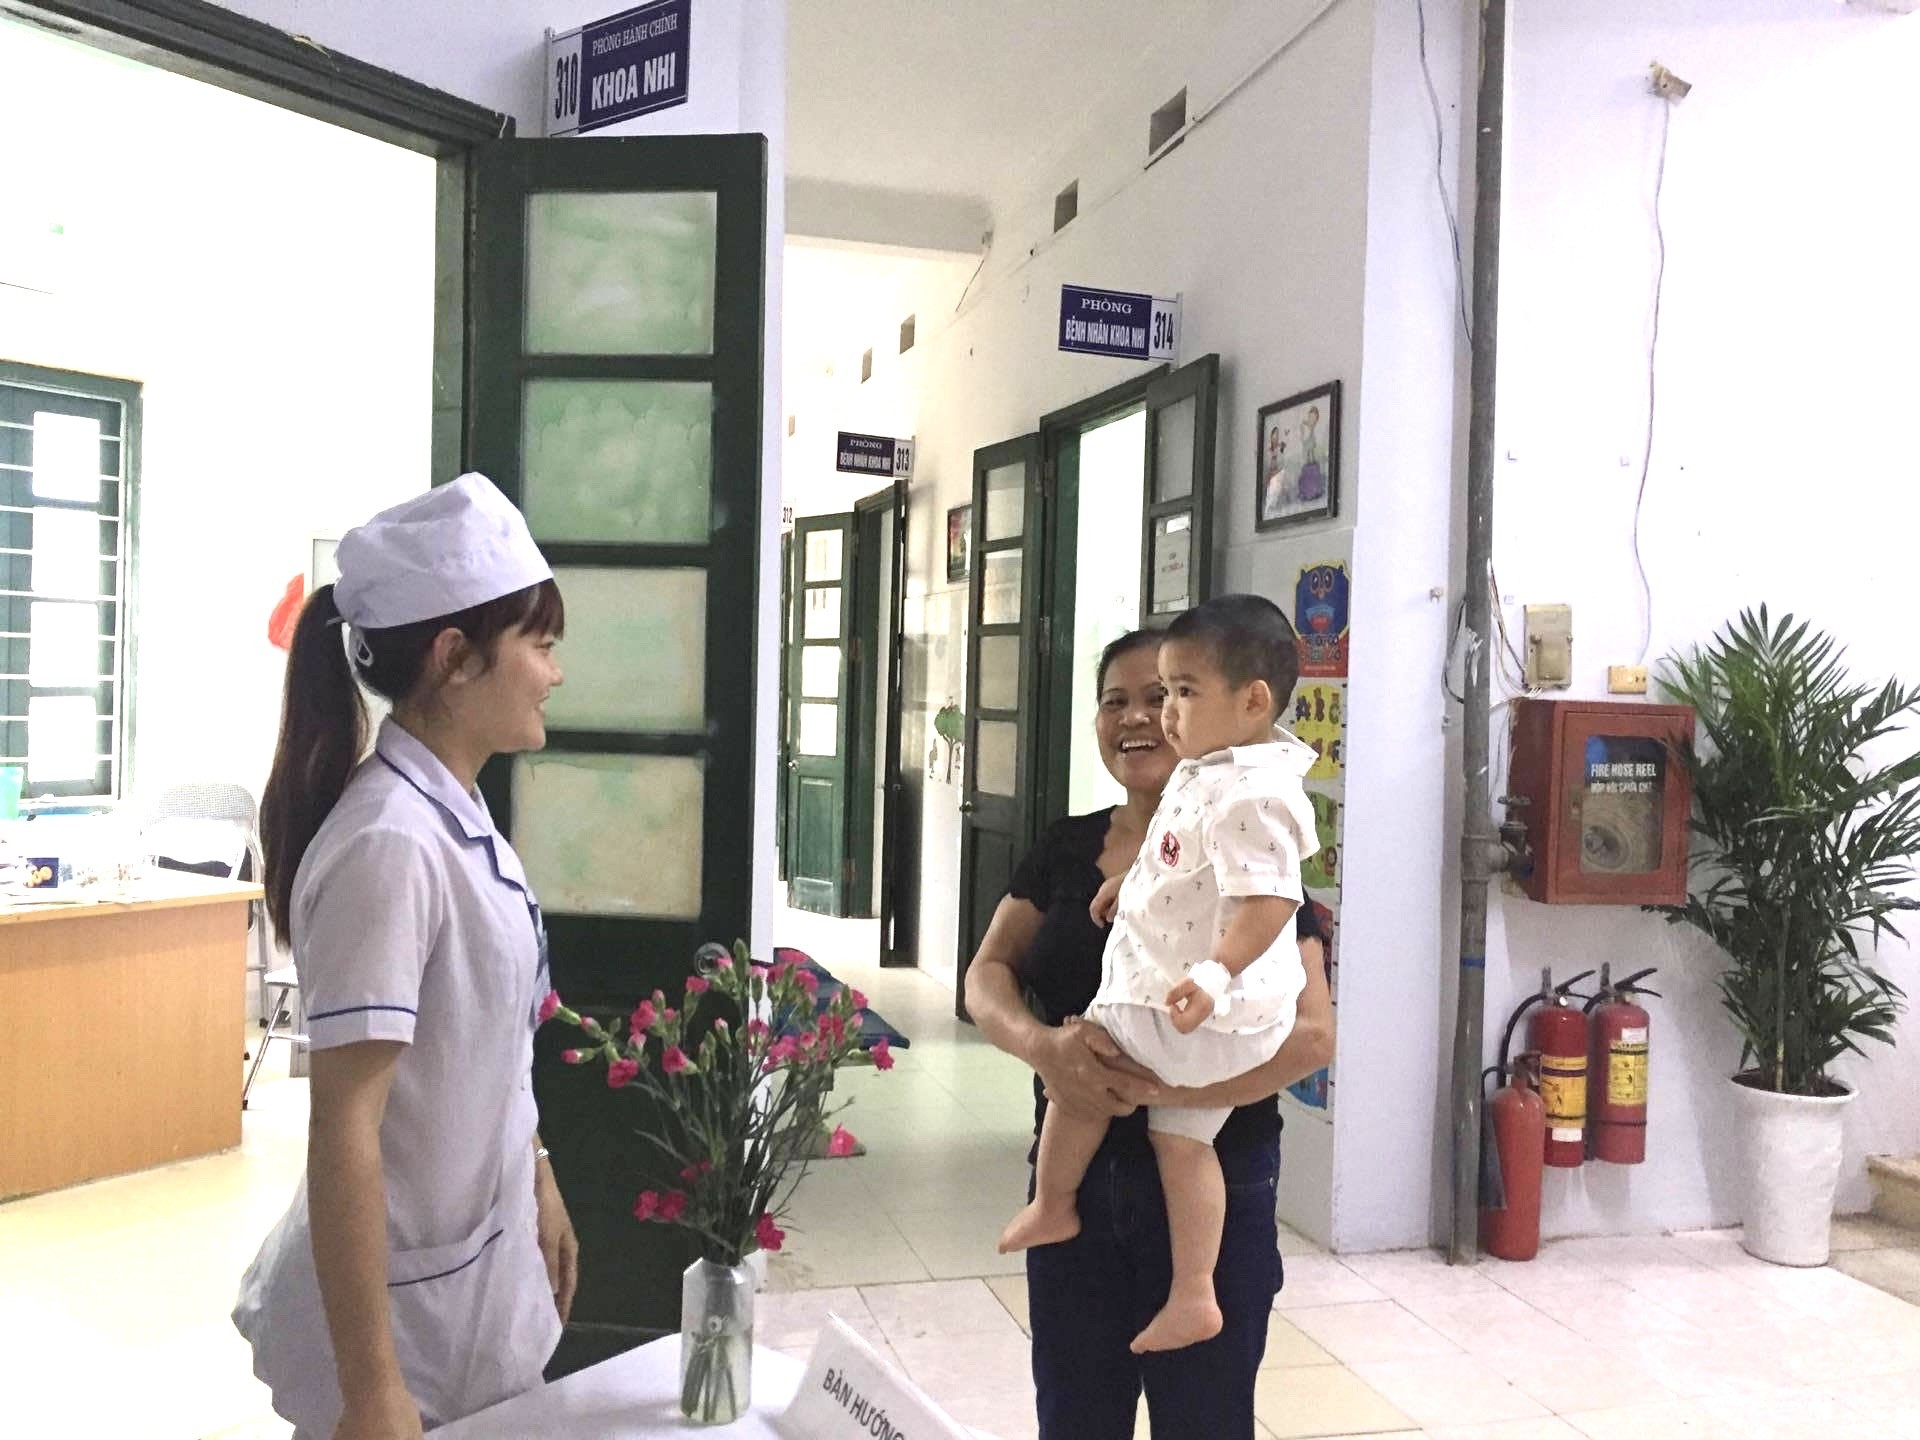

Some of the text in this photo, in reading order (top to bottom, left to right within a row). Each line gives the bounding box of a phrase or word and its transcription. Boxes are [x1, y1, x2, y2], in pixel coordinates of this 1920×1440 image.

[592, 32, 621, 56] PHÒNG
[555, 52, 675, 119] 310 KHOA NHI
[1081, 298, 1173, 350] PHÒNG 314
[1110, 325, 1130, 347] KHOA
[1131, 328, 1145, 349] NHI
[896, 448, 910, 472] 313
[1591, 763, 1656, 777] FIRE HOSE REEL
